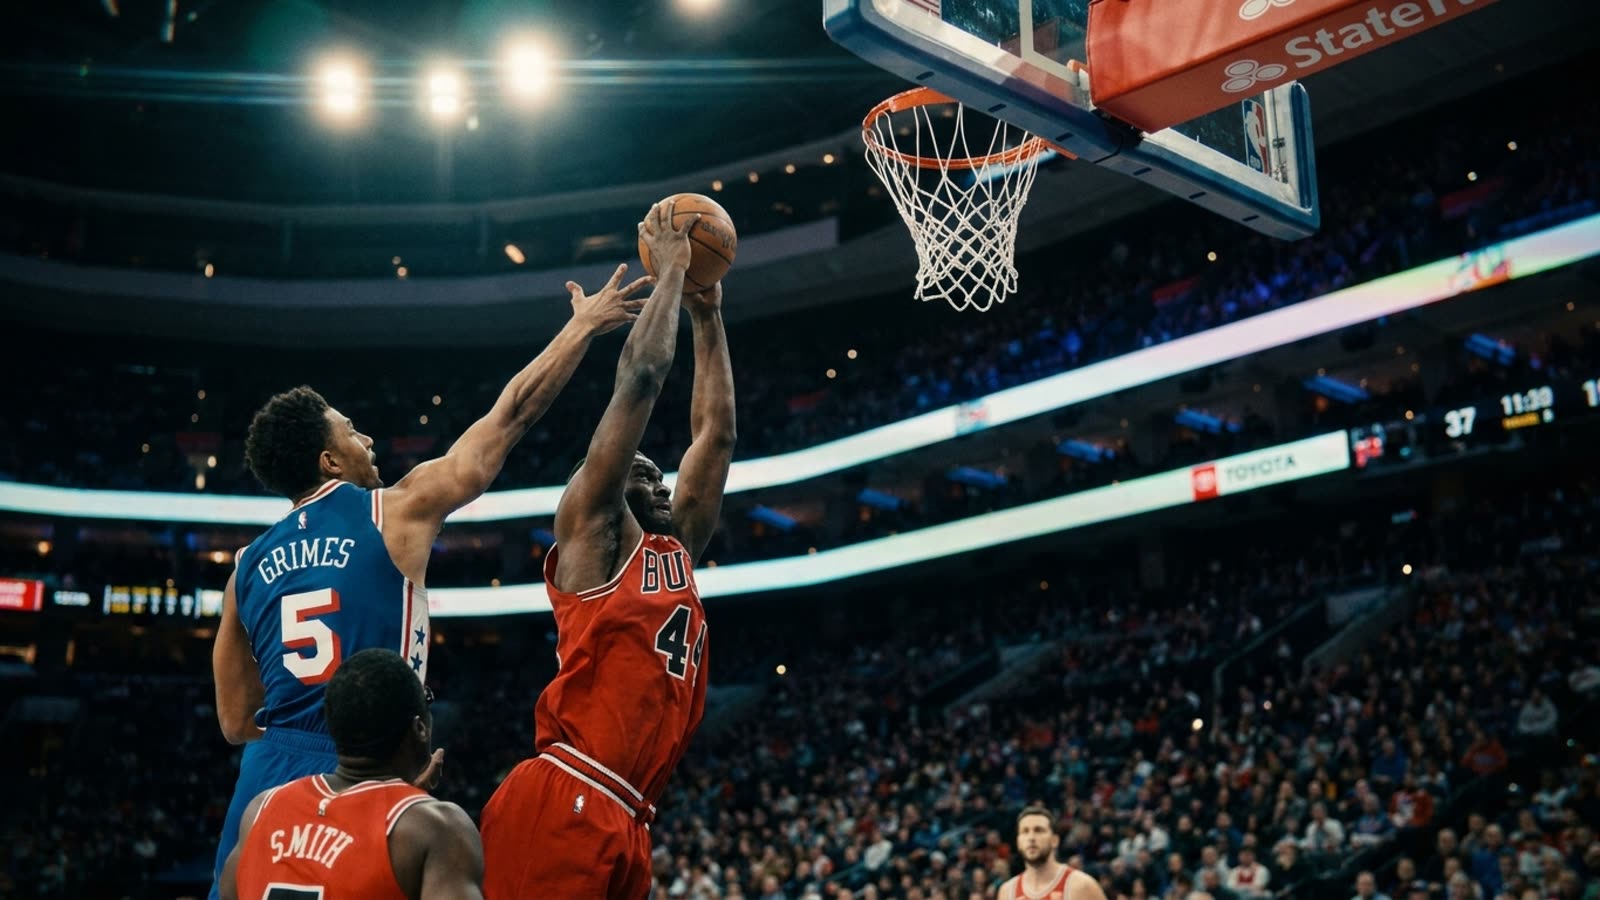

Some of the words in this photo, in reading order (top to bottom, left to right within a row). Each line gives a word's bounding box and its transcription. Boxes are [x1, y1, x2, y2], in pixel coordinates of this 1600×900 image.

[1444, 406, 1476, 438] 37
[1224, 455, 1297, 482] TOYOTA
[258, 537, 355, 585] GRIMES
[641, 547, 693, 594] BU
[281, 588, 341, 686] 5
[270, 823, 354, 869] SMITH
